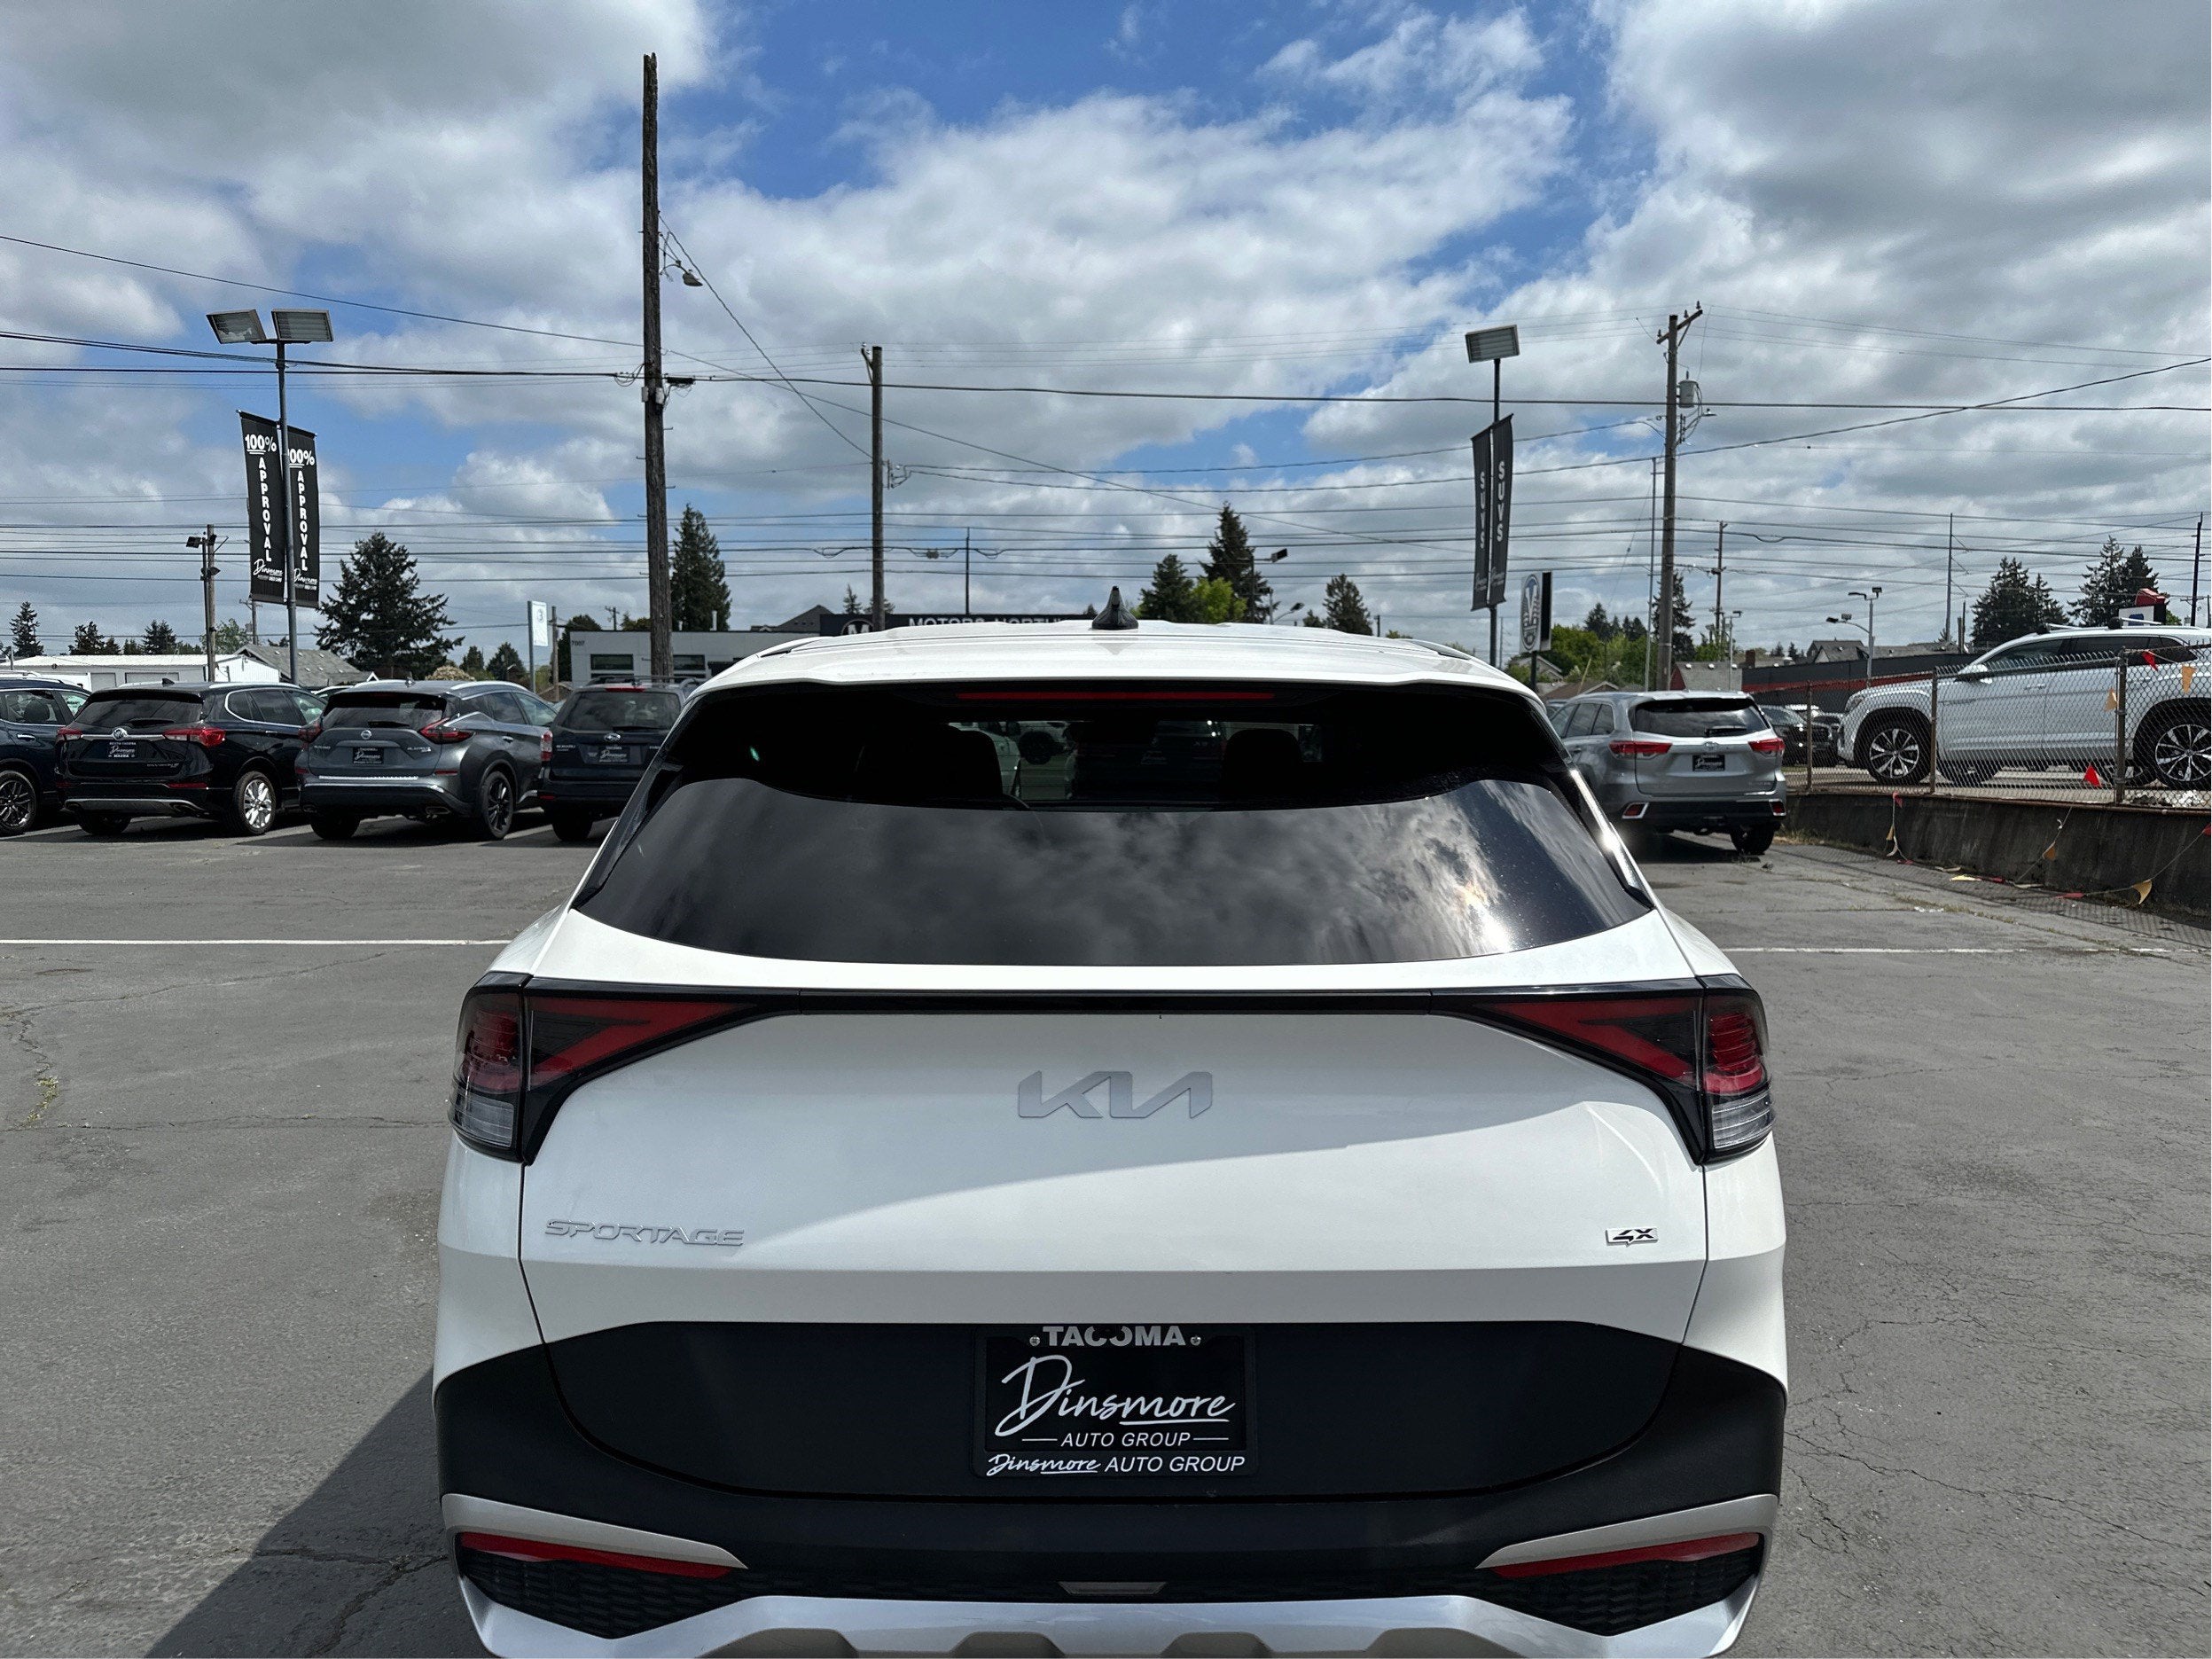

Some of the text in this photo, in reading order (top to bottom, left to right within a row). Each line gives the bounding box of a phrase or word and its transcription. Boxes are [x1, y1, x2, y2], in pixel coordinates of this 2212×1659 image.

[245, 434, 277, 452] 100%
[288, 449, 316, 466] 00%
[258, 457, 272, 562] APPROVAL
[297, 470, 309, 571] APPROVAL
[544, 1218, 746, 1247] SPORTAGE
[1043, 1326, 1186, 1347] TACOMA
[994, 1354, 1236, 1436] Dinsmore
[1060, 1432, 1191, 1448] AUTO GROUP
[986, 1452, 1246, 1476] Dinsmore AUTO GROUP
